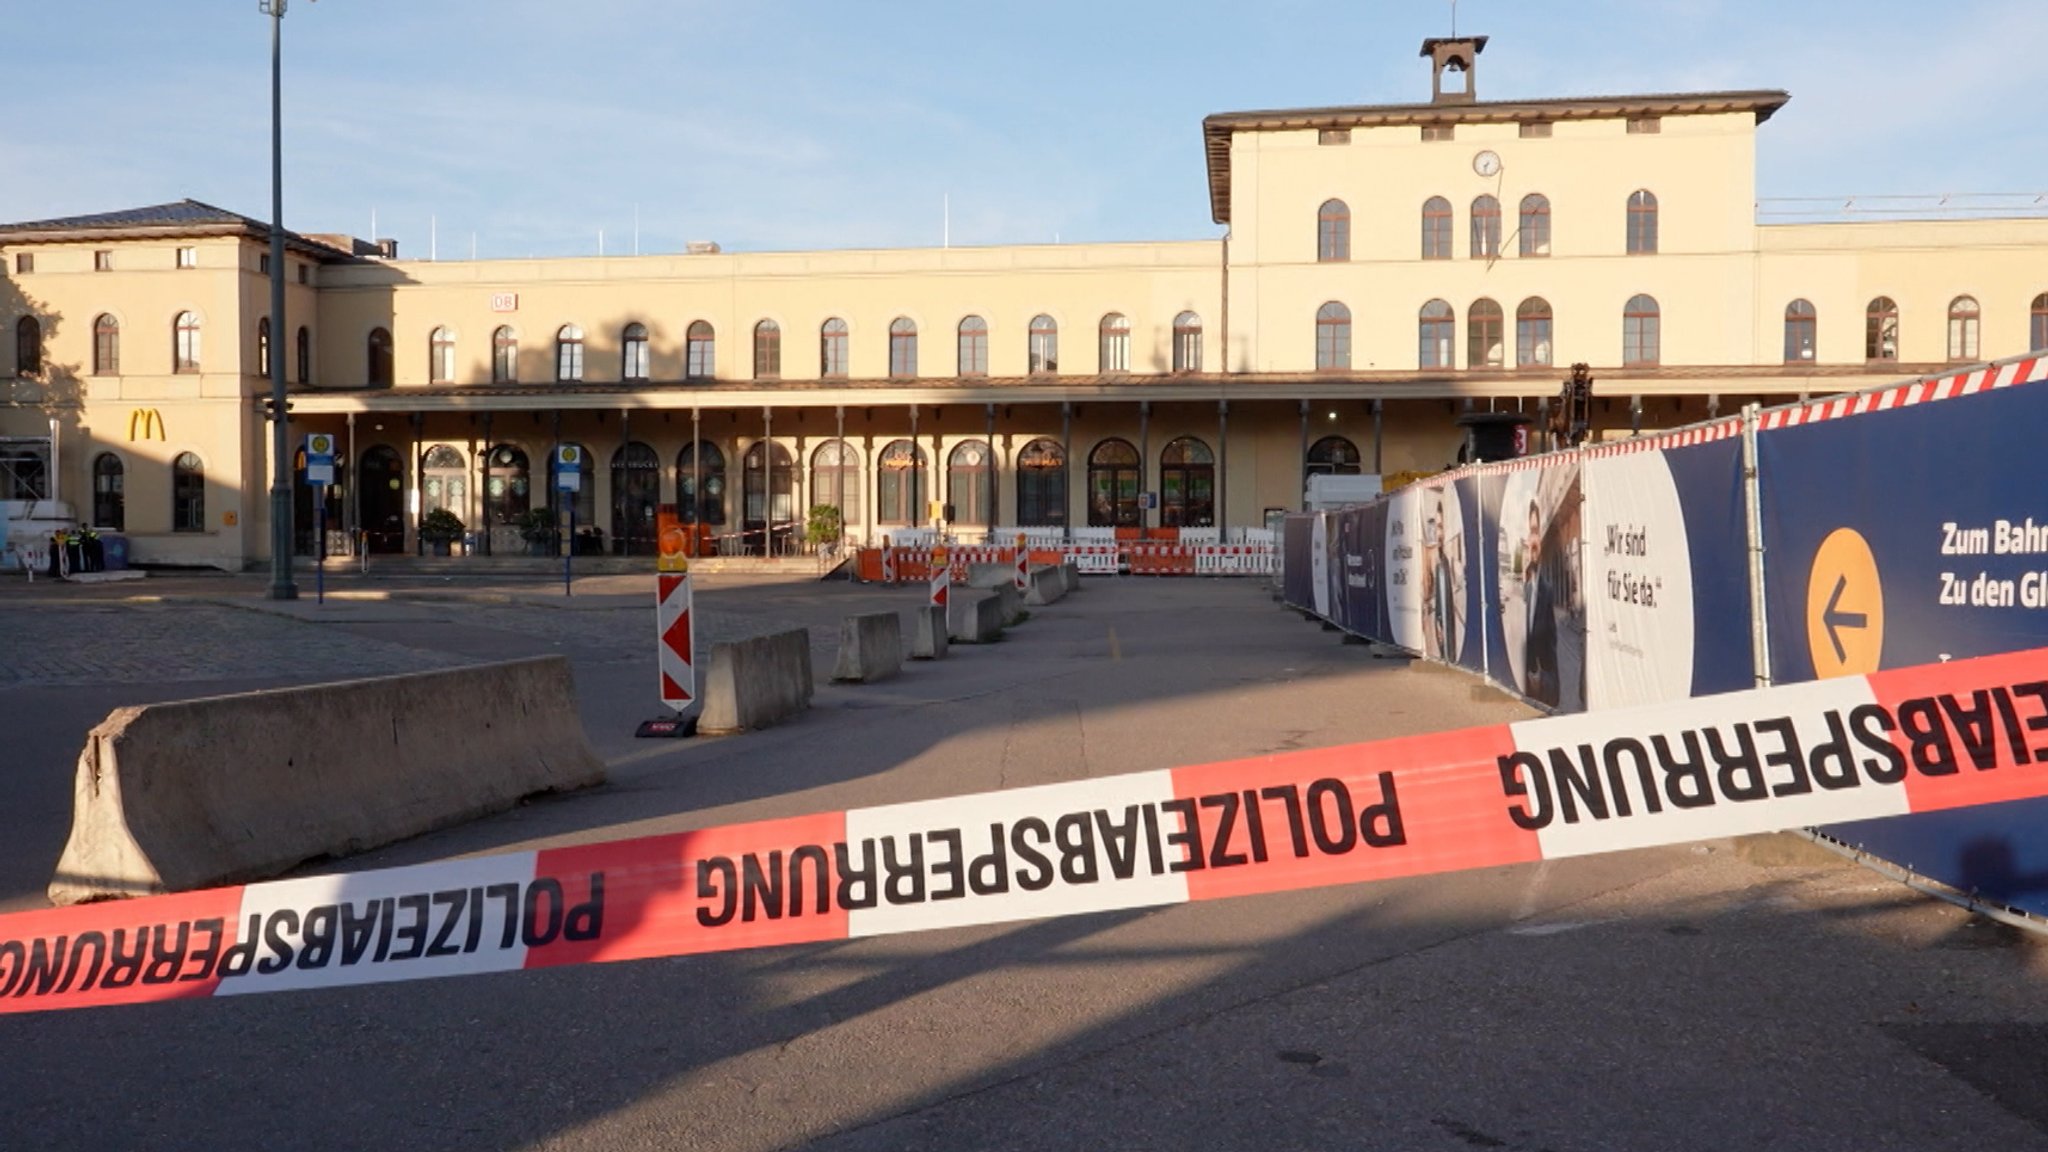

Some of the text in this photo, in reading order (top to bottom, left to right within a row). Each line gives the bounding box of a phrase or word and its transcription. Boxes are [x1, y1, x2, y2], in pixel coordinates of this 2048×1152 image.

[494, 294, 513, 309] DB
[1625, 523, 1646, 556] sind
[1941, 521, 1989, 554] Zum
[1607, 568, 1621, 600] für
[1623, 571, 1638, 604] Sie
[1939, 570, 2048, 609] Zu den Gl
[1497, 680, 2048, 830] EIABSPERRUNG
[696, 770, 1408, 928] POLIZEIABSPERRUNG
[0, 871, 606, 998] POLIZEIABSPERRUNG
